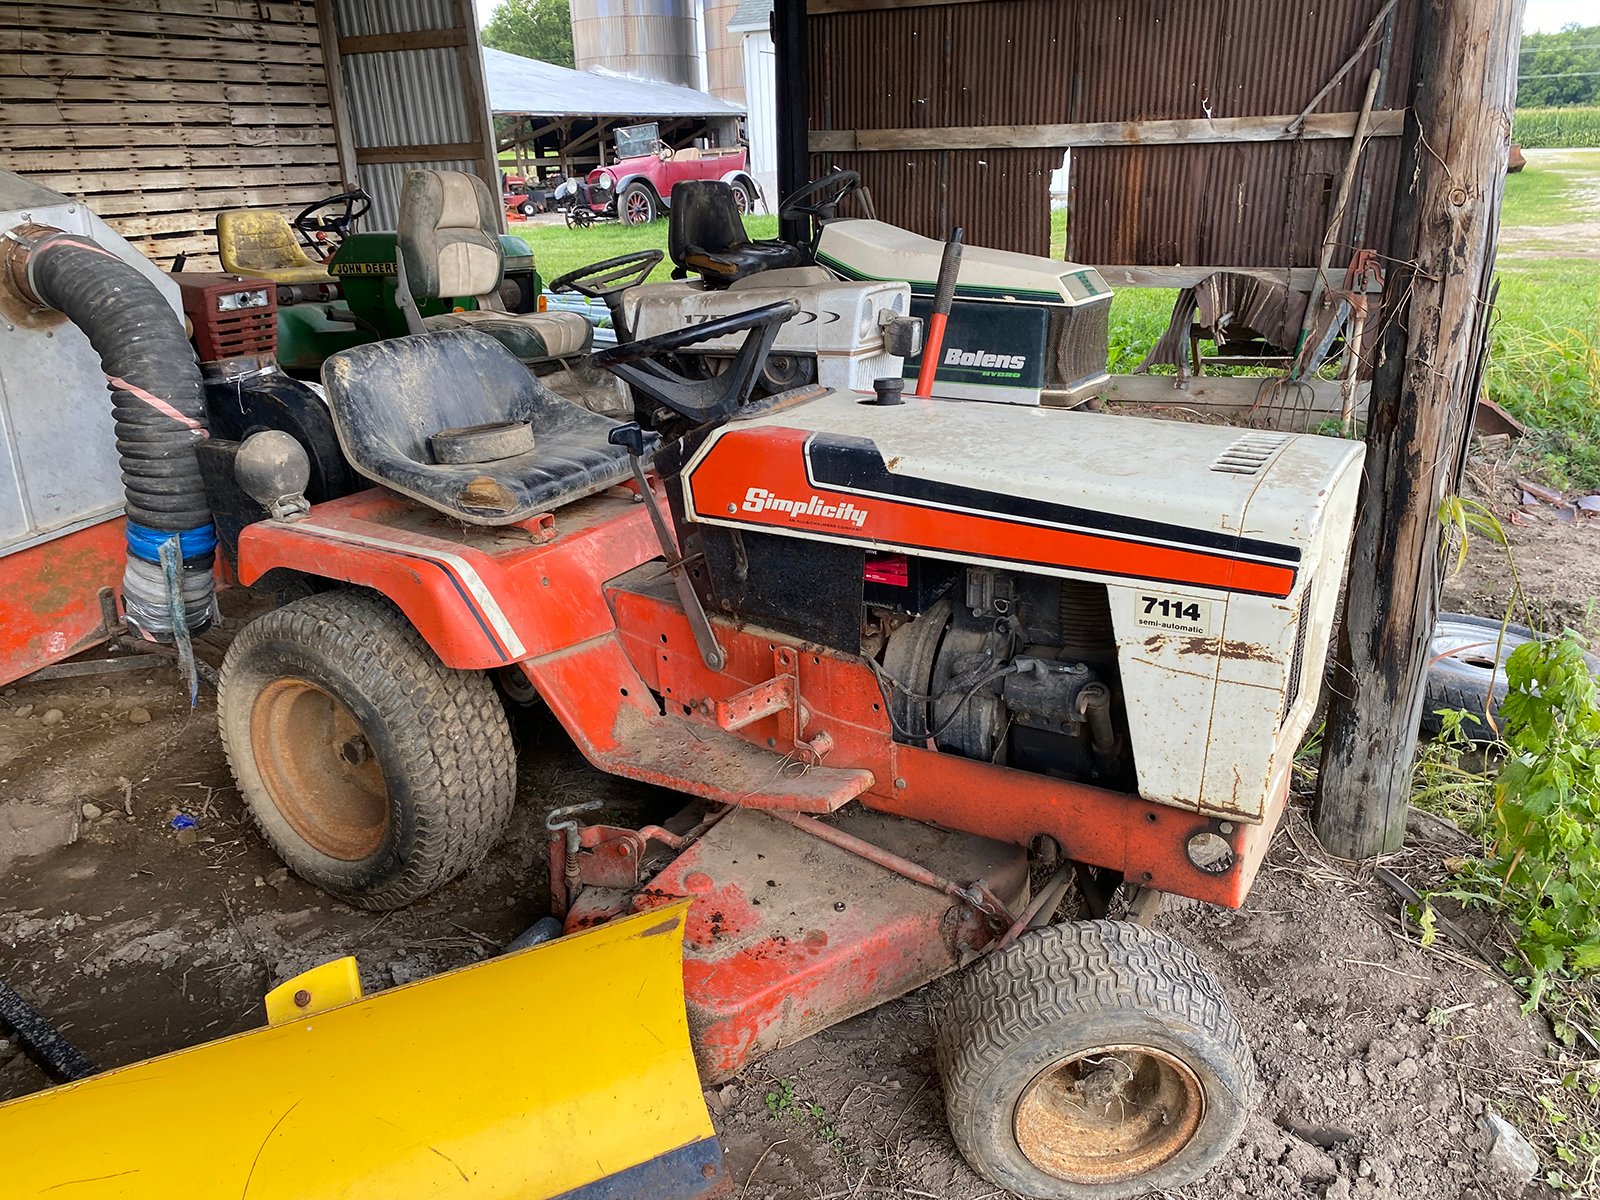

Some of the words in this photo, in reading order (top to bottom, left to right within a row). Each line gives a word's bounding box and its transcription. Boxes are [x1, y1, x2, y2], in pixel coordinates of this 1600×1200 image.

[337, 263, 361, 273] JOHN
[366, 263, 398, 273] DEERE
[944, 348, 1026, 370] Bolens
[742, 487, 868, 527] Simplicity
[1142, 596, 1201, 621] 7114
[1138, 619, 1204, 634] semi-automatic
